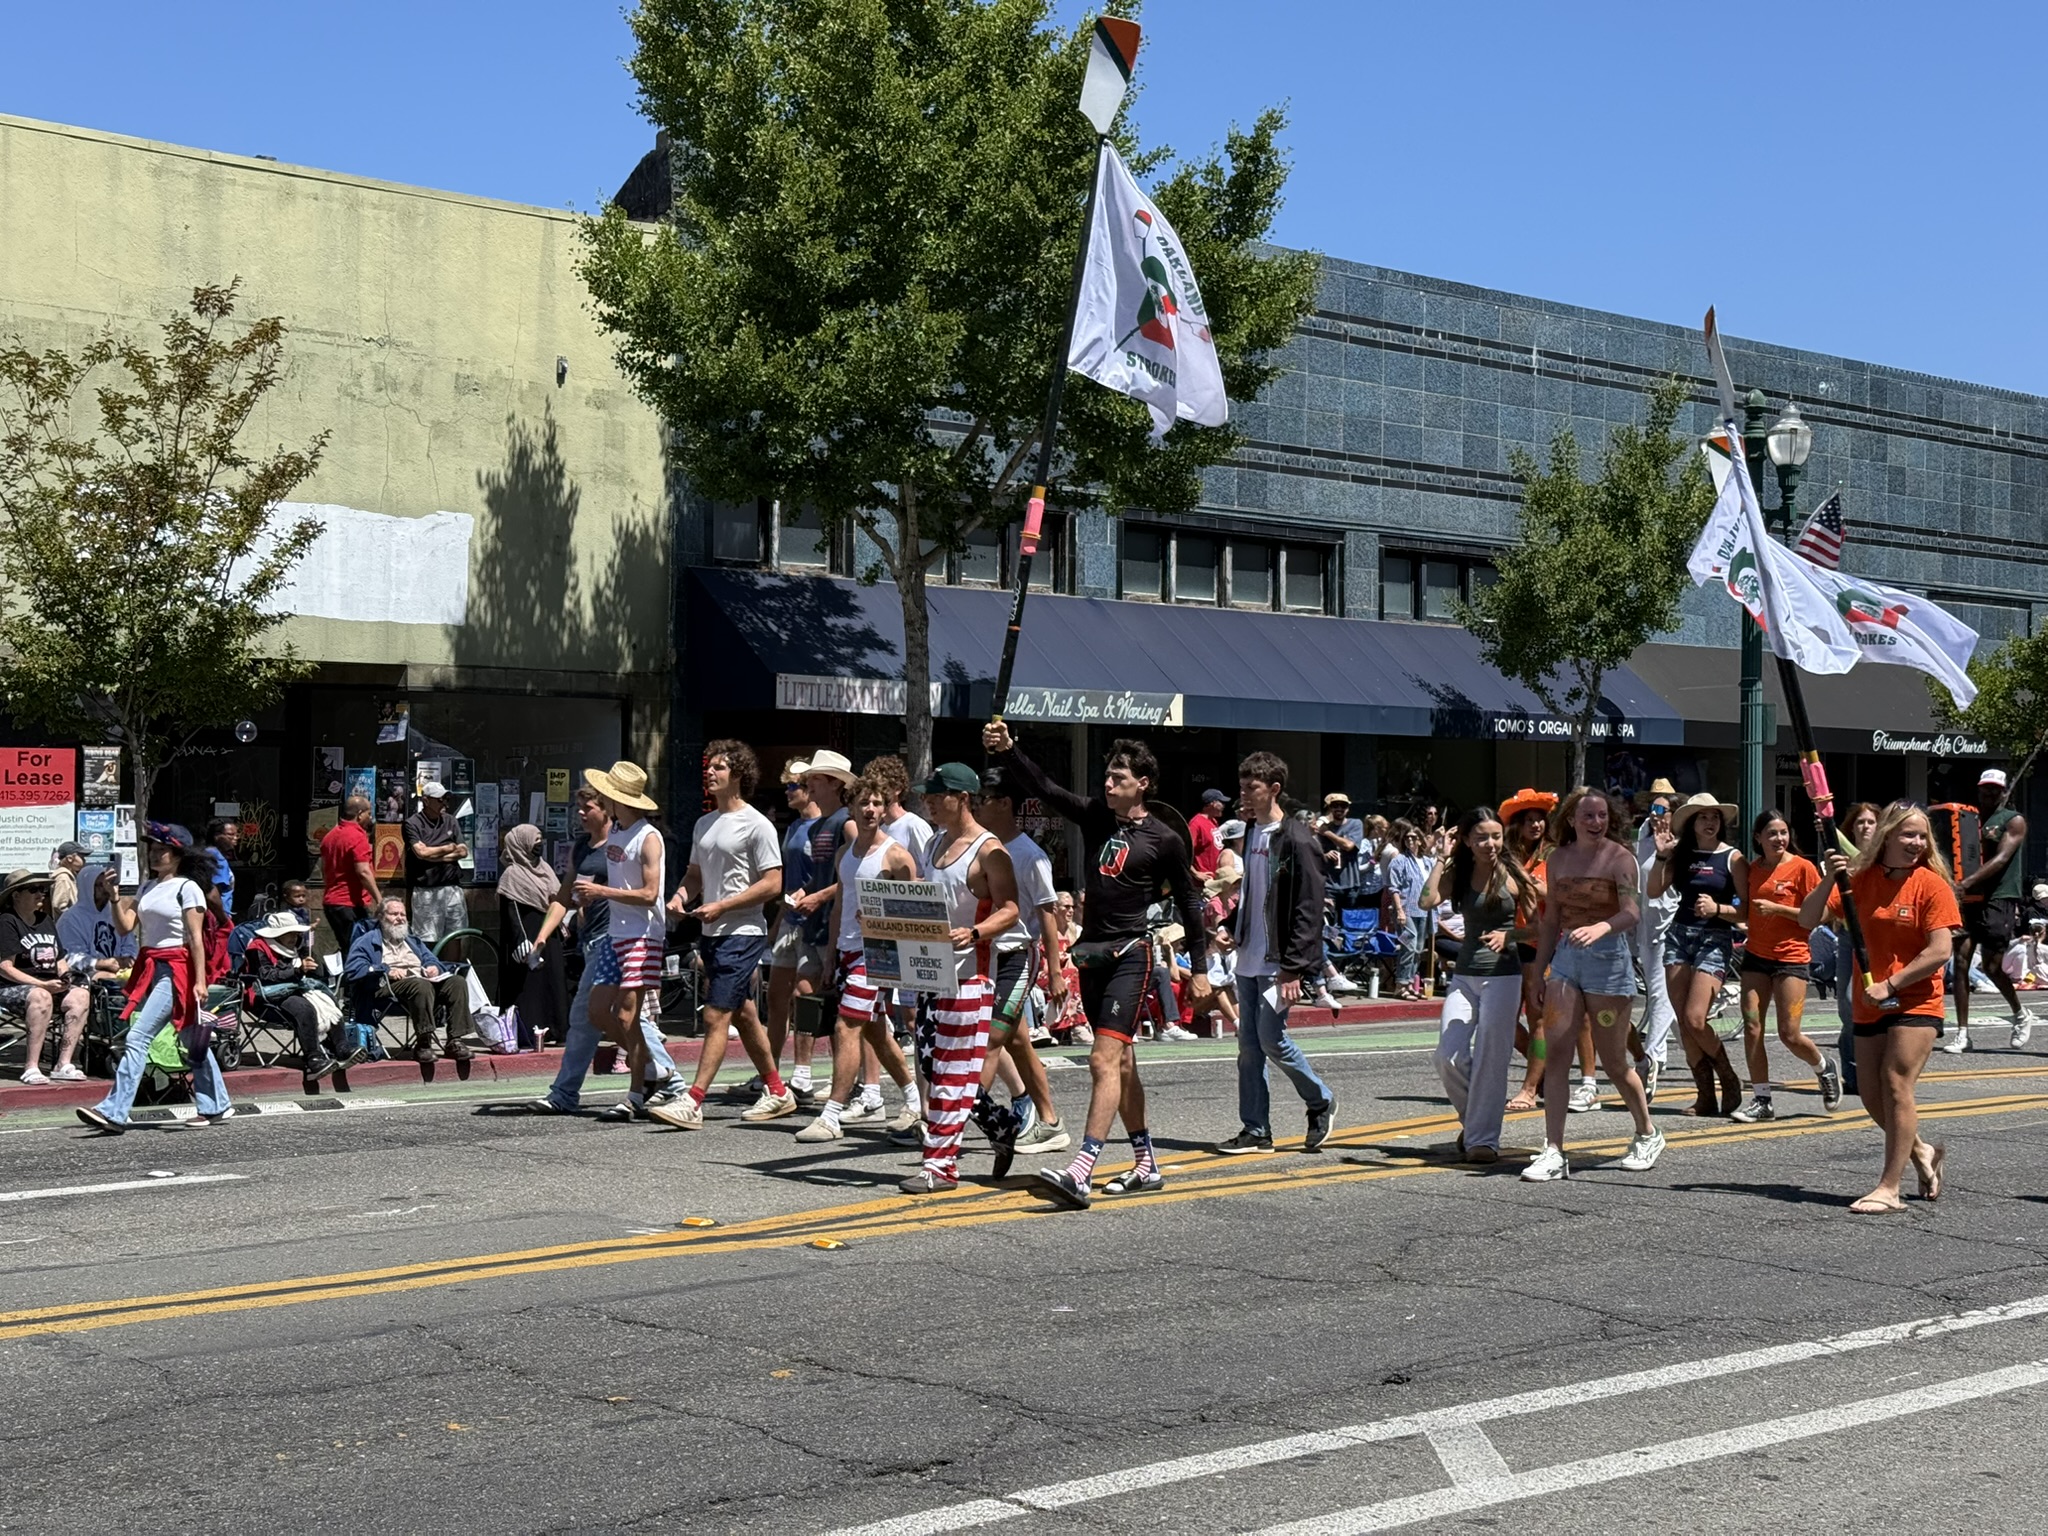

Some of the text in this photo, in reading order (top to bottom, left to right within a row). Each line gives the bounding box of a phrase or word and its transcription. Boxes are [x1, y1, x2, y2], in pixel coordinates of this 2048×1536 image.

[1155, 235, 1205, 317] OAKLAND
[1037, 690, 1072, 718] Nail
[1075, 695, 1100, 722] Spa
[1103, 694, 1115, 719] &
[1117, 694, 1163, 725] Waxing
[1494, 718, 1535, 734] TOMO'S
[1591, 722, 1613, 737] NAIL
[1617, 723, 1635, 738] SPA
[1872, 730, 1988, 757] Triumphant Life Church
[17, 751, 52, 767] For
[4, 769, 64, 786] Lease
[0, 790, 70, 801] 415.395.7262
[26, 814, 47, 823] Choi
[0, 836, 64, 845] eff Badstubner
[861, 881, 937, 897] LEARN TO ROW!
[863, 906, 882, 917] WANTED
[866, 920, 943, 934] OAKLAND STROKES
[919, 945, 929, 956] NO
[909, 956, 943, 969] EXPERIENCE
[916, 969, 938, 981] NEEDED
